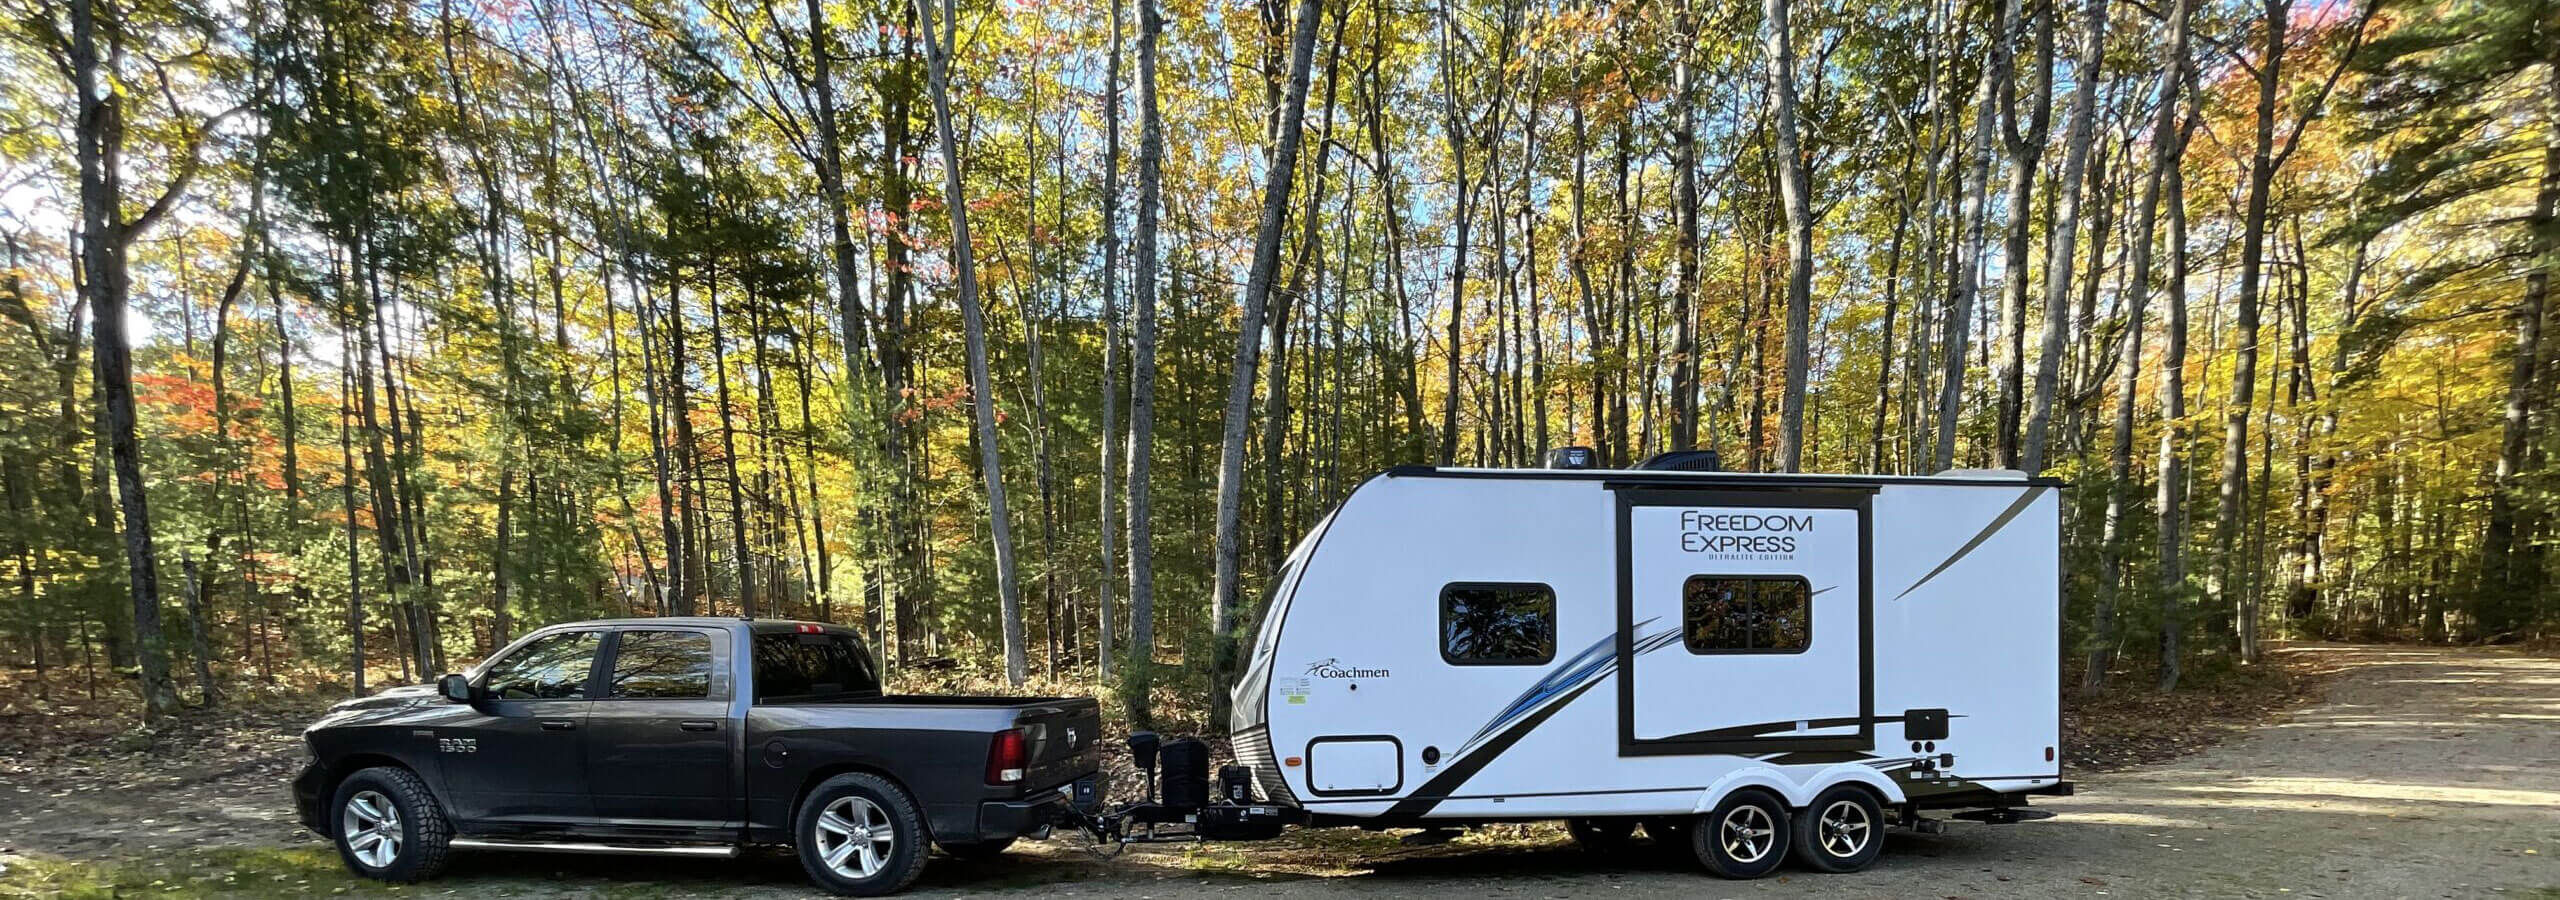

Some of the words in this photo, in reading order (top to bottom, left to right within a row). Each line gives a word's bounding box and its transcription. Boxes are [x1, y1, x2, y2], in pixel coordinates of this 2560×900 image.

[1681, 510, 1813, 532] FREEDOM
[1681, 532, 1796, 552] EXPRESS
[1320, 667, 1390, 679] Coachmen
[439, 738, 477, 746] RAM
[439, 745, 477, 753] 1500
